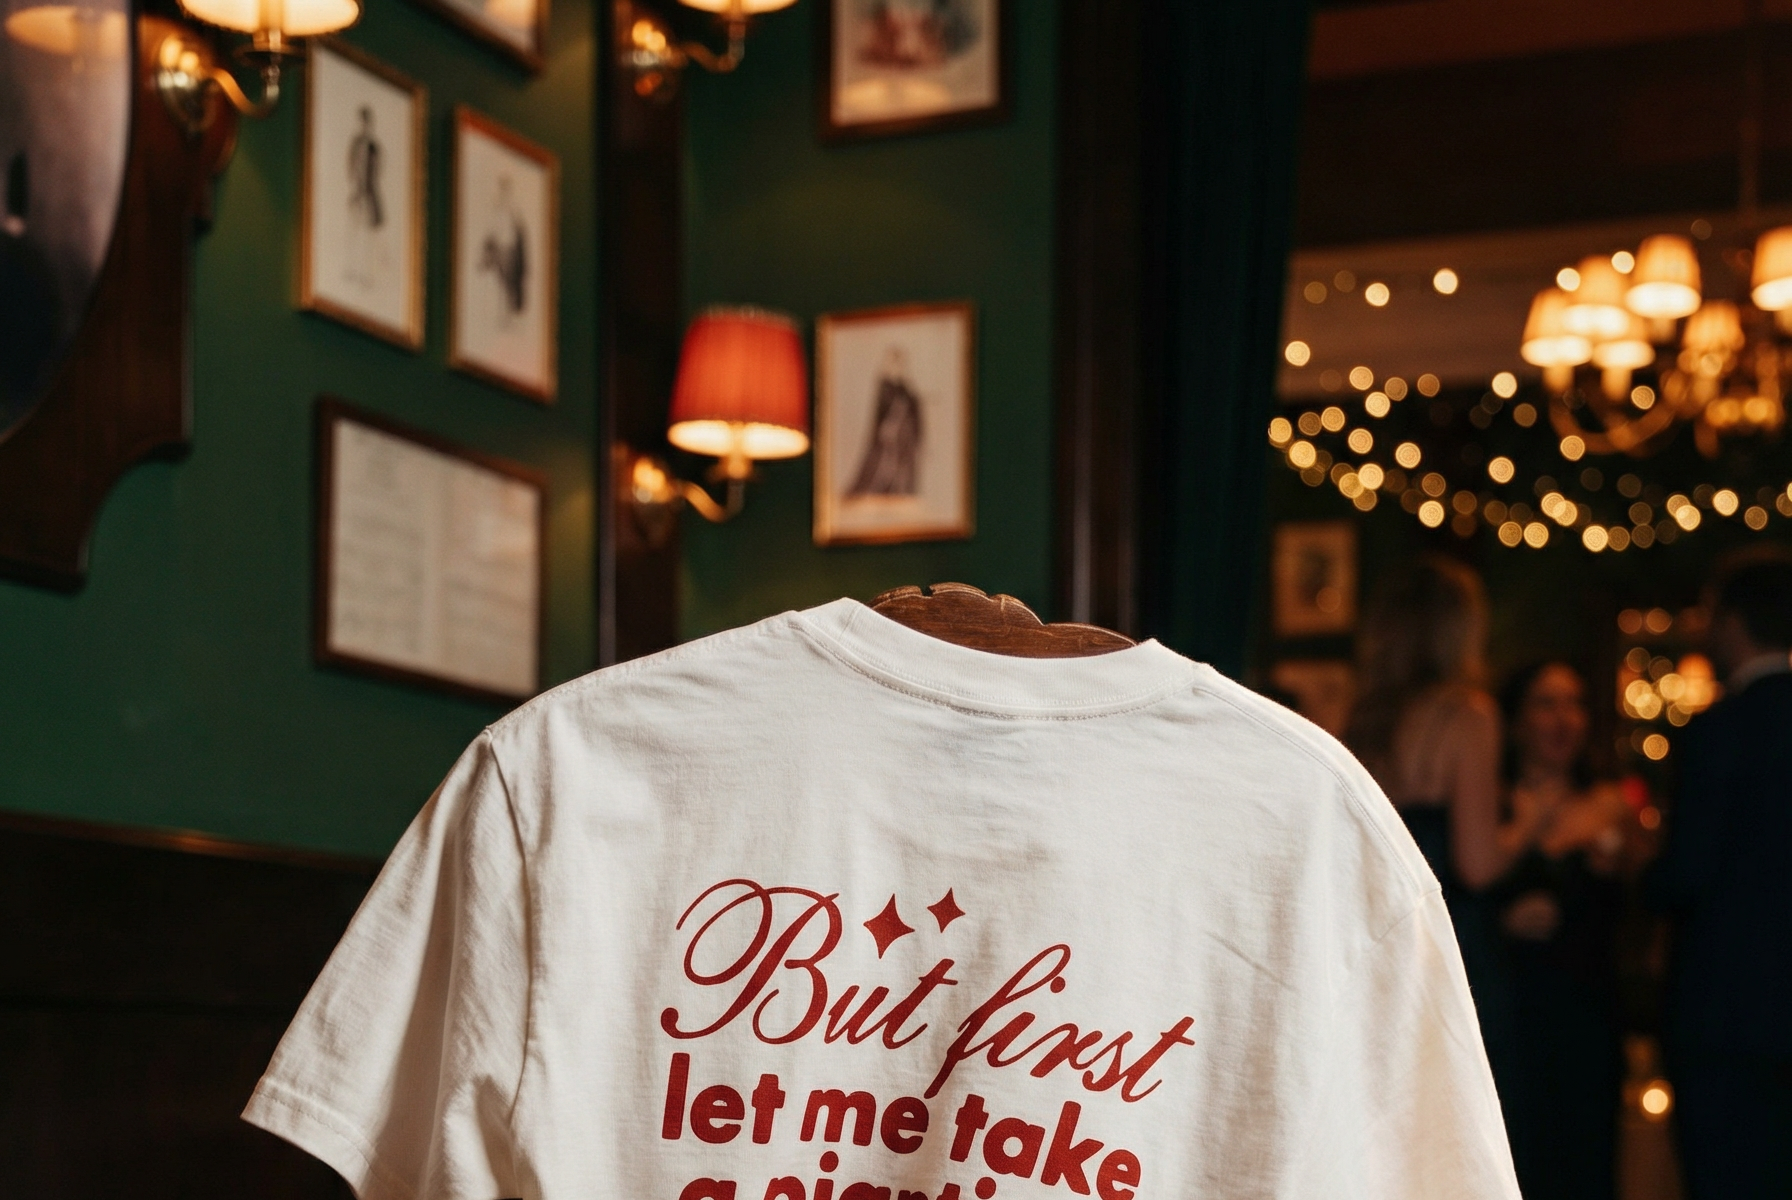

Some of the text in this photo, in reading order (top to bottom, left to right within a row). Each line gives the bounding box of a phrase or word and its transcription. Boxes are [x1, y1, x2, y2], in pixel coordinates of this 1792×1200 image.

[660, 878, 1195, 1103] But first
[661, 1052, 786, 1145] let
[799, 1088, 930, 1154] me
